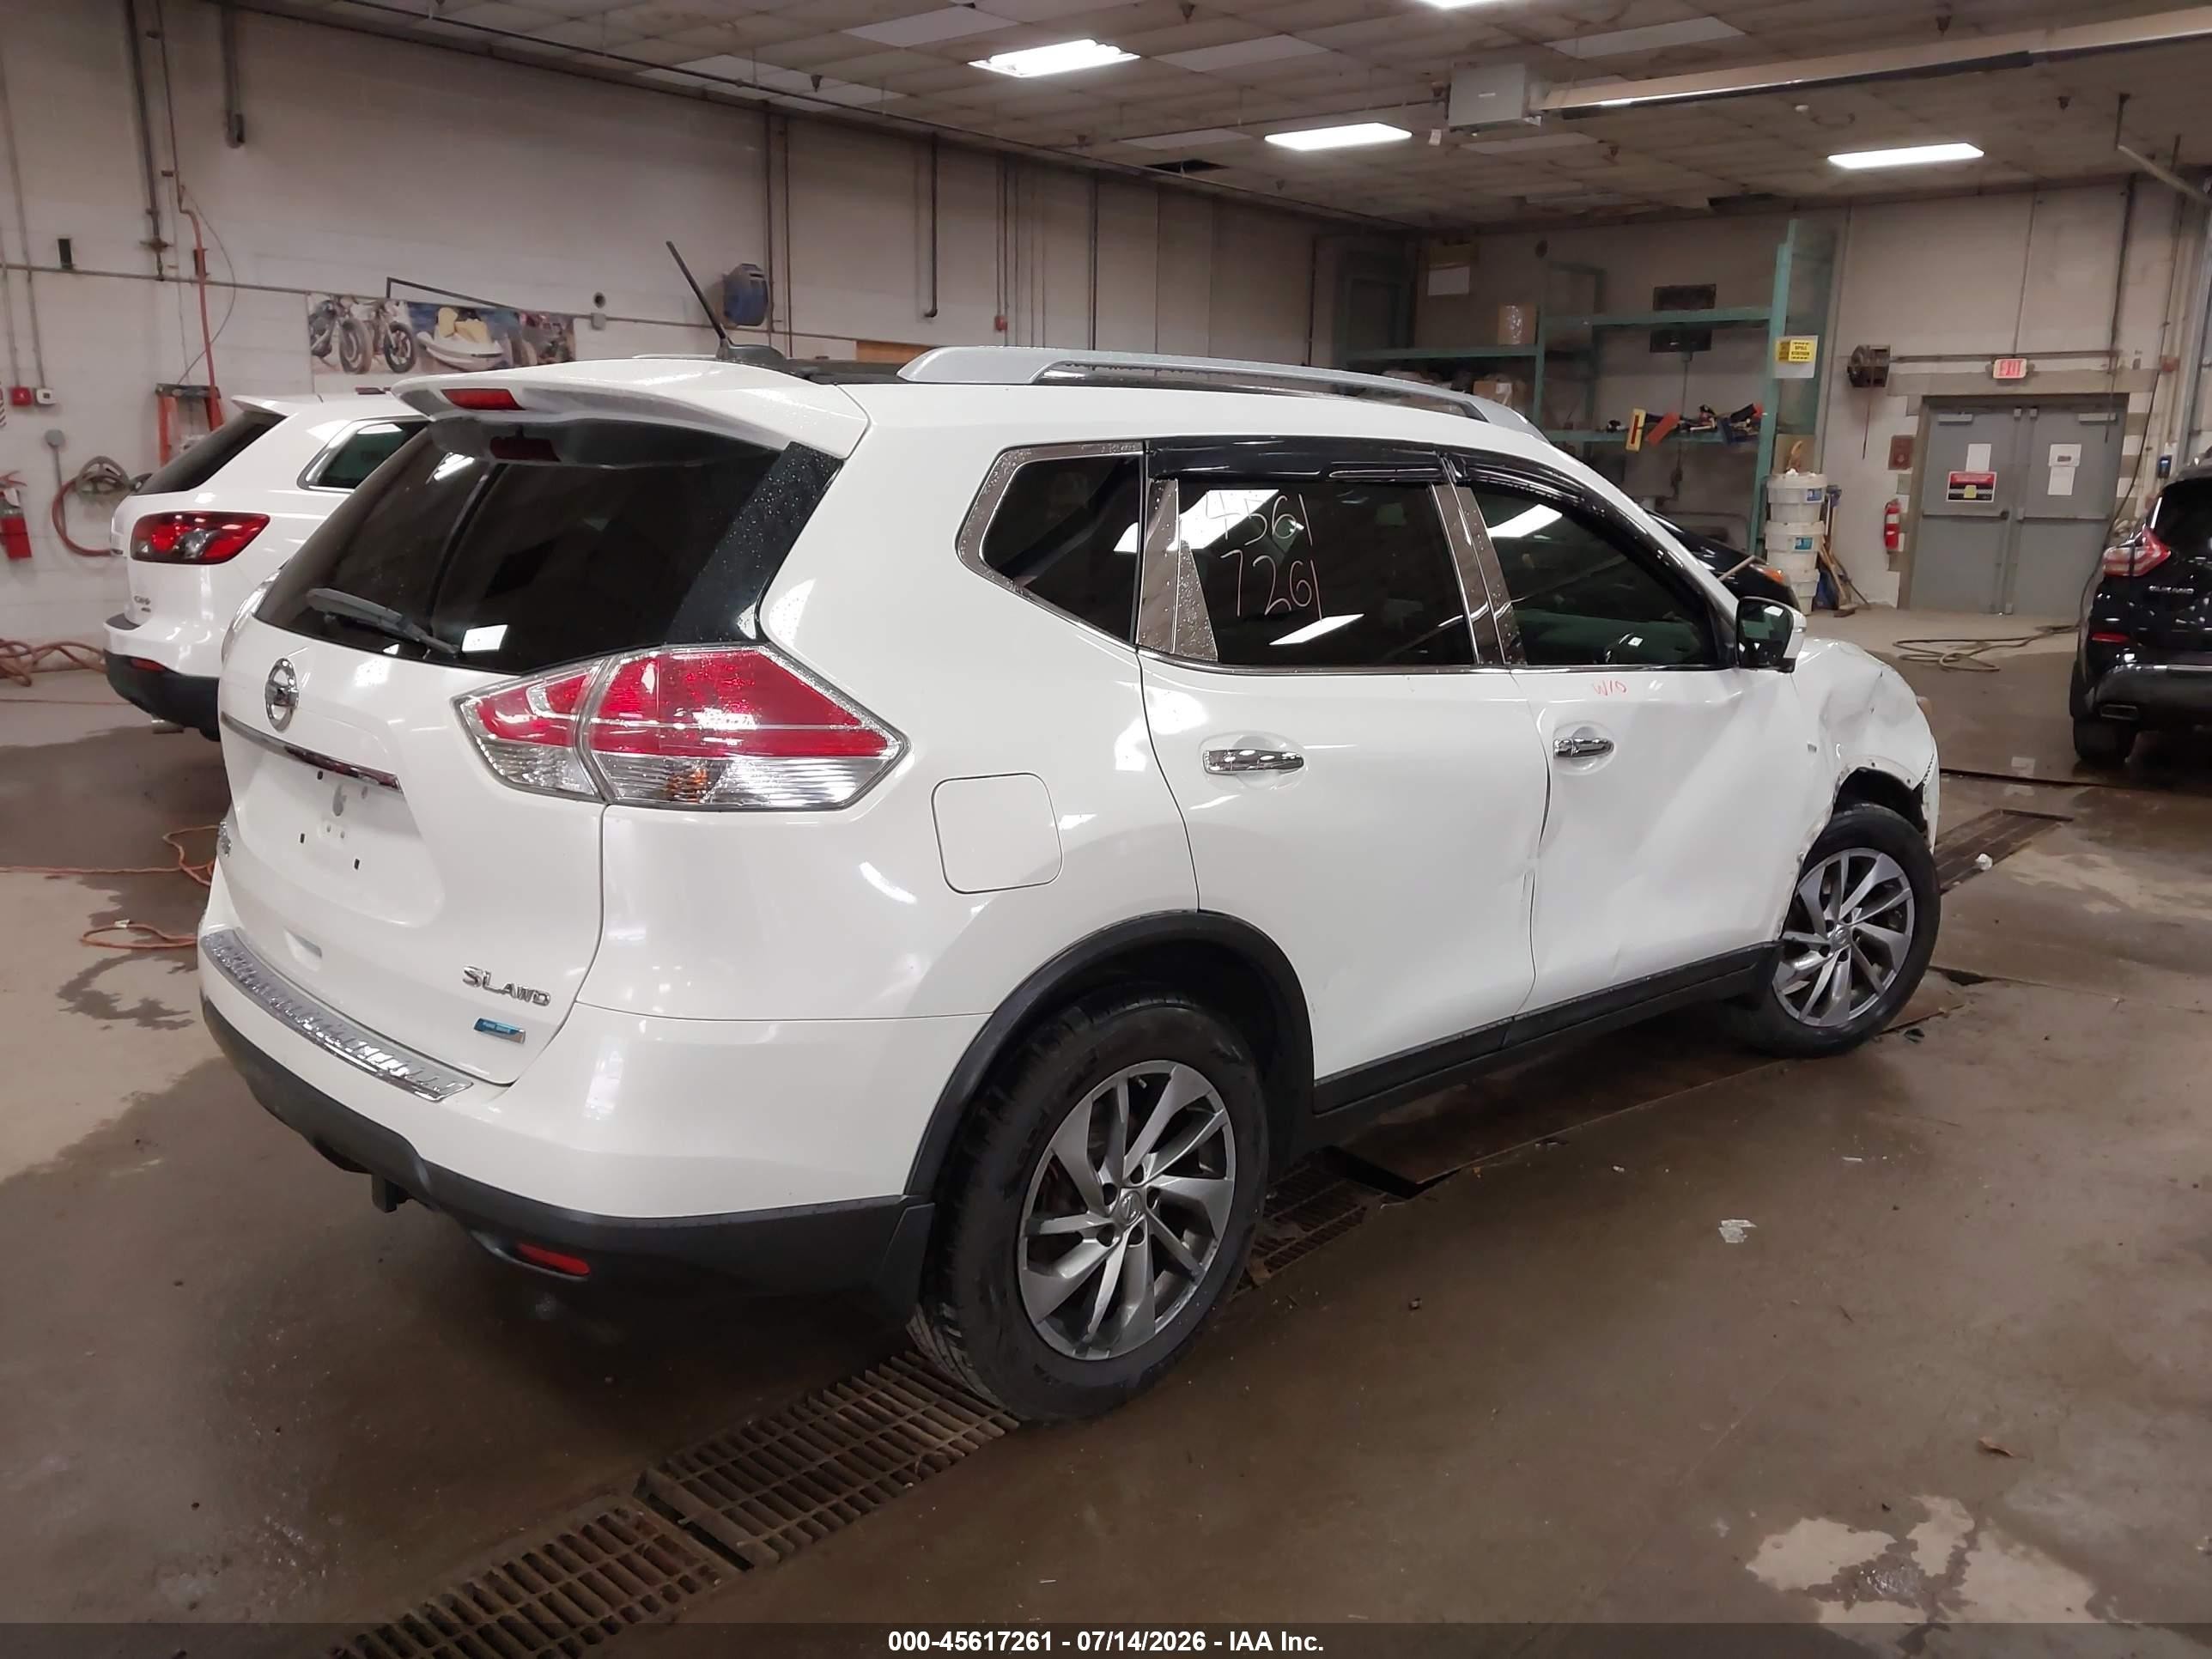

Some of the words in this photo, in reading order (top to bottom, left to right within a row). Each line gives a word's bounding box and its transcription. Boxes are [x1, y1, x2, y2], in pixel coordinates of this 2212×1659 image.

[1999, 360, 2022, 376] EXIT
[1205, 491, 1314, 547] 4561
[1219, 549, 1323, 623] 7261
[462, 965, 501, 994] SL
[501, 982, 551, 1007] AWD
